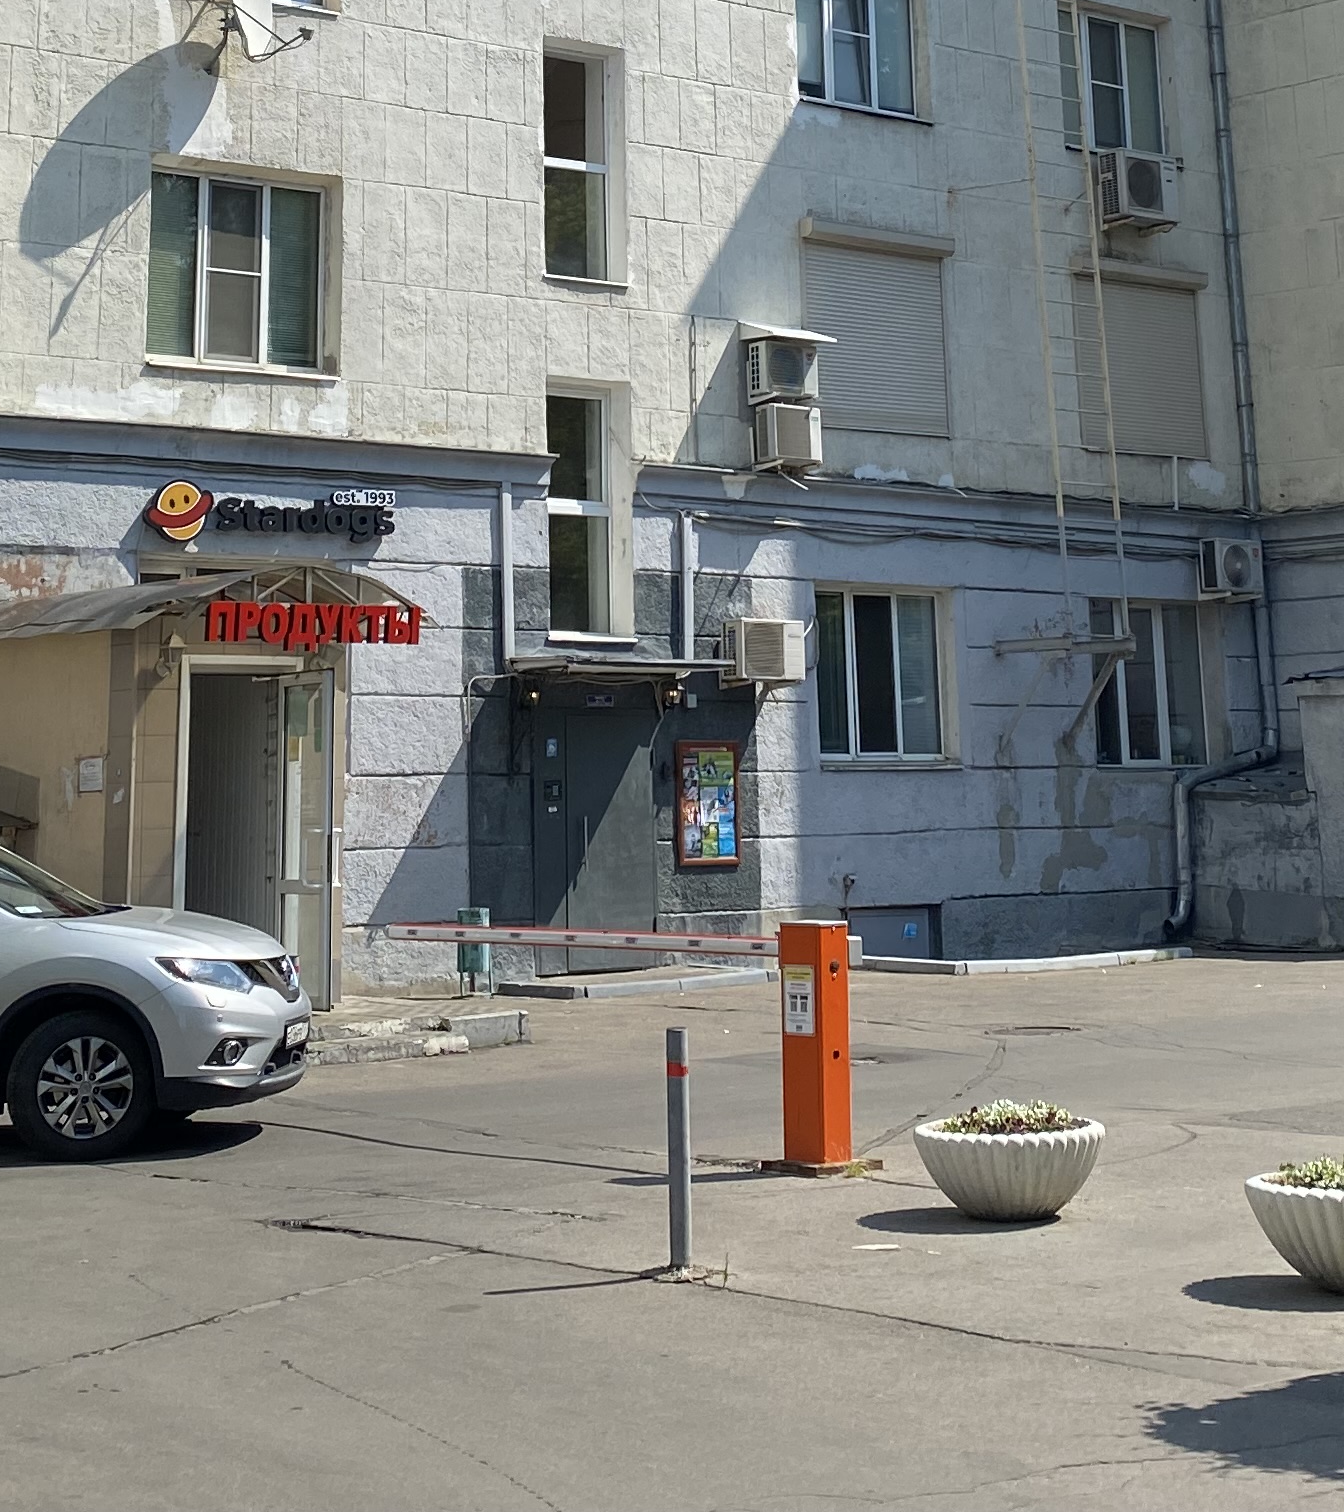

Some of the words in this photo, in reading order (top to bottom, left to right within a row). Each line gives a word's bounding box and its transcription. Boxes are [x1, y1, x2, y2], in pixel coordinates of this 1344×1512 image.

[216, 497, 395, 541] Stardogs
[334, 491, 360, 504] est.
[364, 491, 394, 505] 1993
[206, 601, 420, 651] ПРОДУКТЫ
